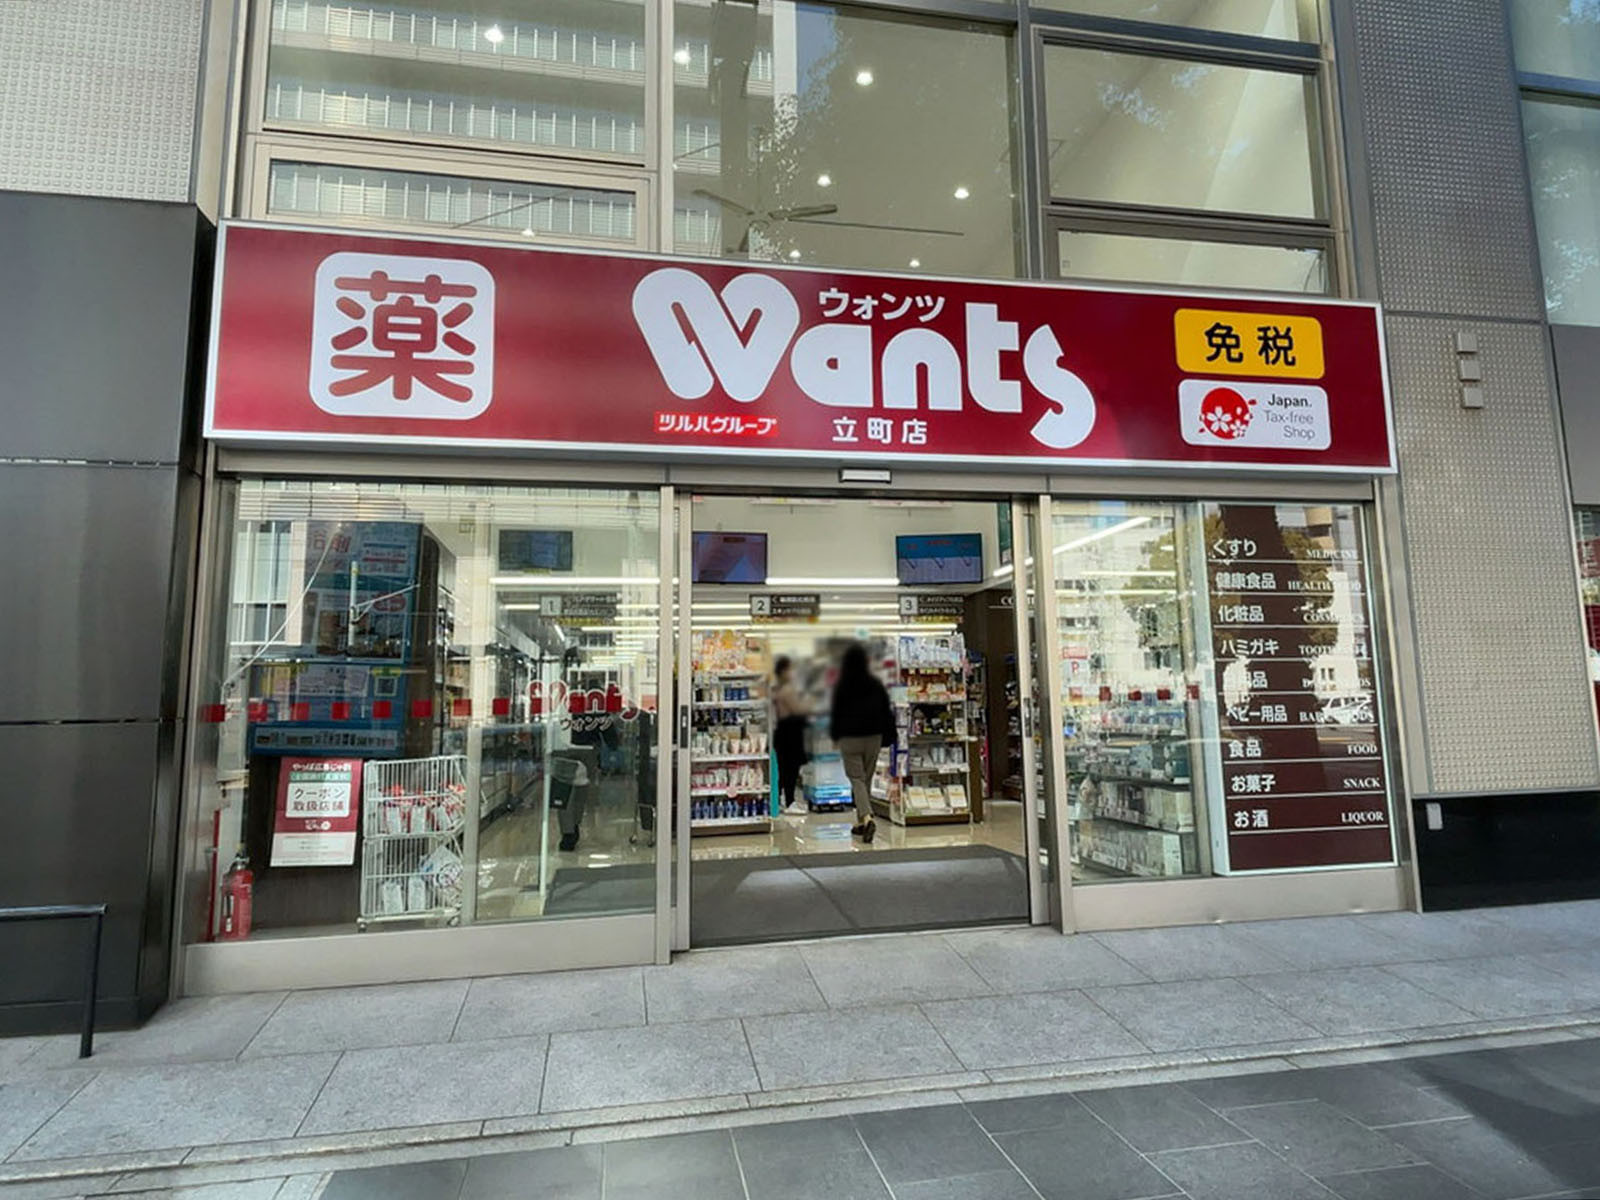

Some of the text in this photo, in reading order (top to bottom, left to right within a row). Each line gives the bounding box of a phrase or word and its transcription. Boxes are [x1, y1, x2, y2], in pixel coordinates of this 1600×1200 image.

[818, 288, 945, 323] ウォンツ
[329, 270, 477, 403] 薬
[1205, 322, 1296, 367] 免税
[632, 268, 1096, 449] Wants
[1268, 393, 1313, 409] Japan.
[658, 414, 776, 436] ツルハグループ
[1264, 410, 1314, 425] Tax-free
[832, 416, 927, 445] 立町店
[1283, 425, 1316, 440] Shop
[1213, 539, 1257, 557] くすり
[1215, 572, 1276, 589] 健康食品
[1288, 580, 1331, 591] HEALTH
[756, 600, 765, 612] 2
[904, 600, 913, 611] 3
[1219, 605, 1264, 622] 化粧品
[1221, 639, 1279, 656] ハミガキ
[1226, 671, 1268, 688] 用品
[1300, 712, 1332, 723] BAB
[1229, 739, 1261, 758] 食品
[1347, 743, 1378, 755] FOOD
[1231, 775, 1276, 792] お菓子
[1343, 777, 1381, 789] SNACK
[294, 788, 345, 800] クーポン
[1234, 810, 1268, 828] お酒
[1341, 811, 1384, 824] LIQUOR
